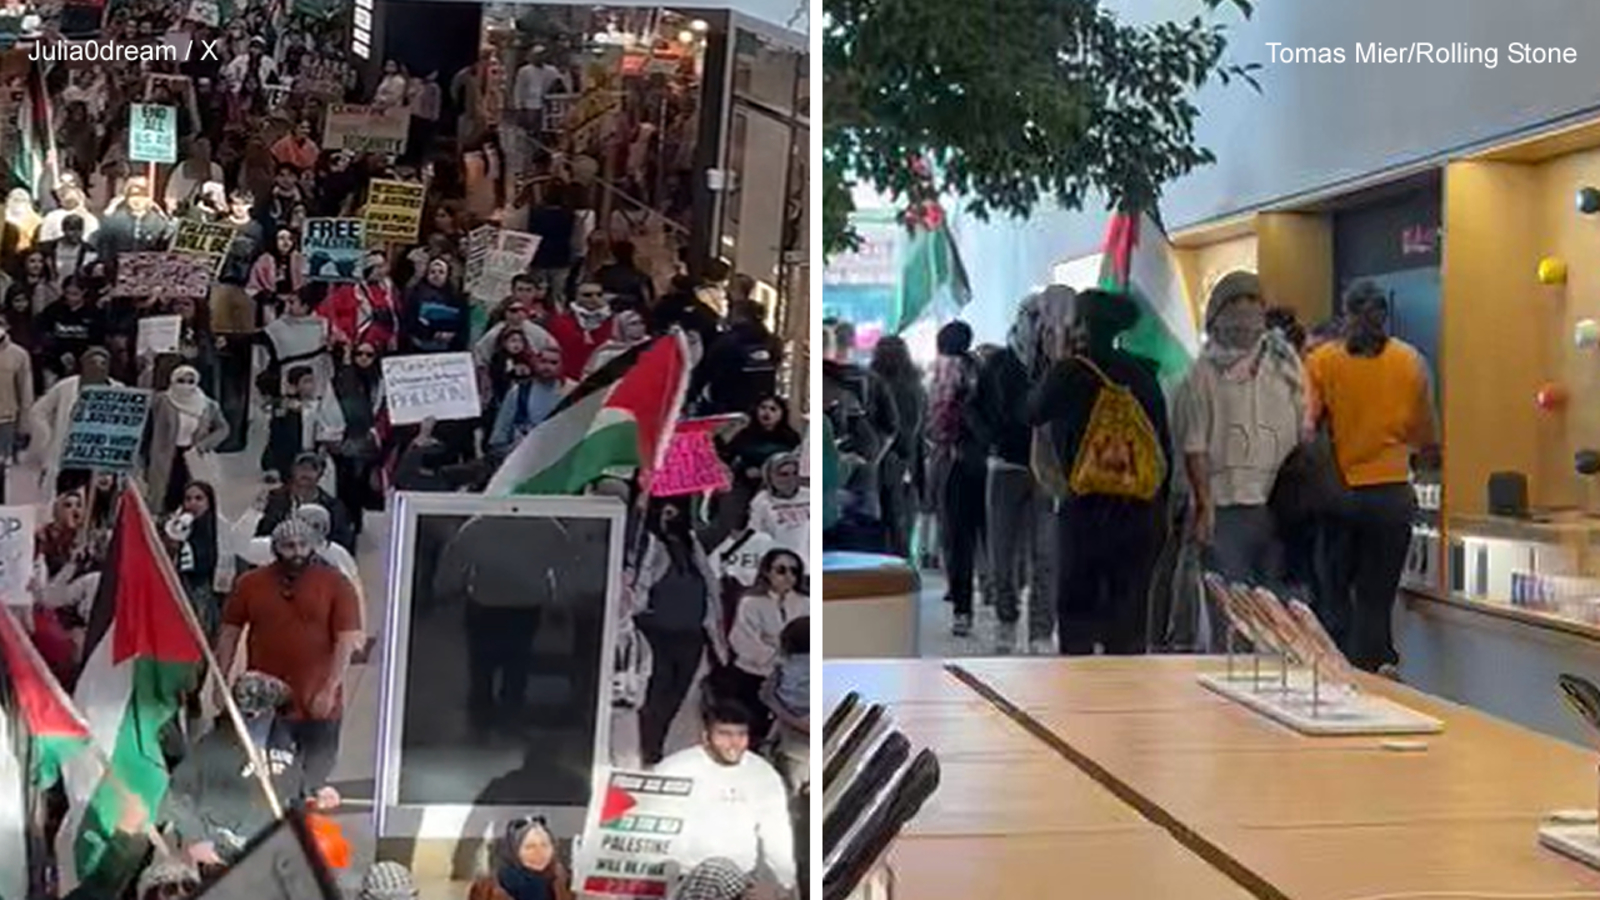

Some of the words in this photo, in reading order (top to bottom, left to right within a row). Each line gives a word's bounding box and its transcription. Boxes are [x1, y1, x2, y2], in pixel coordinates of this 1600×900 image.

[309, 220, 361, 239] FREE
[64, 445, 133, 461] PALESTINE
[602, 834, 671, 855] PALESTINE
